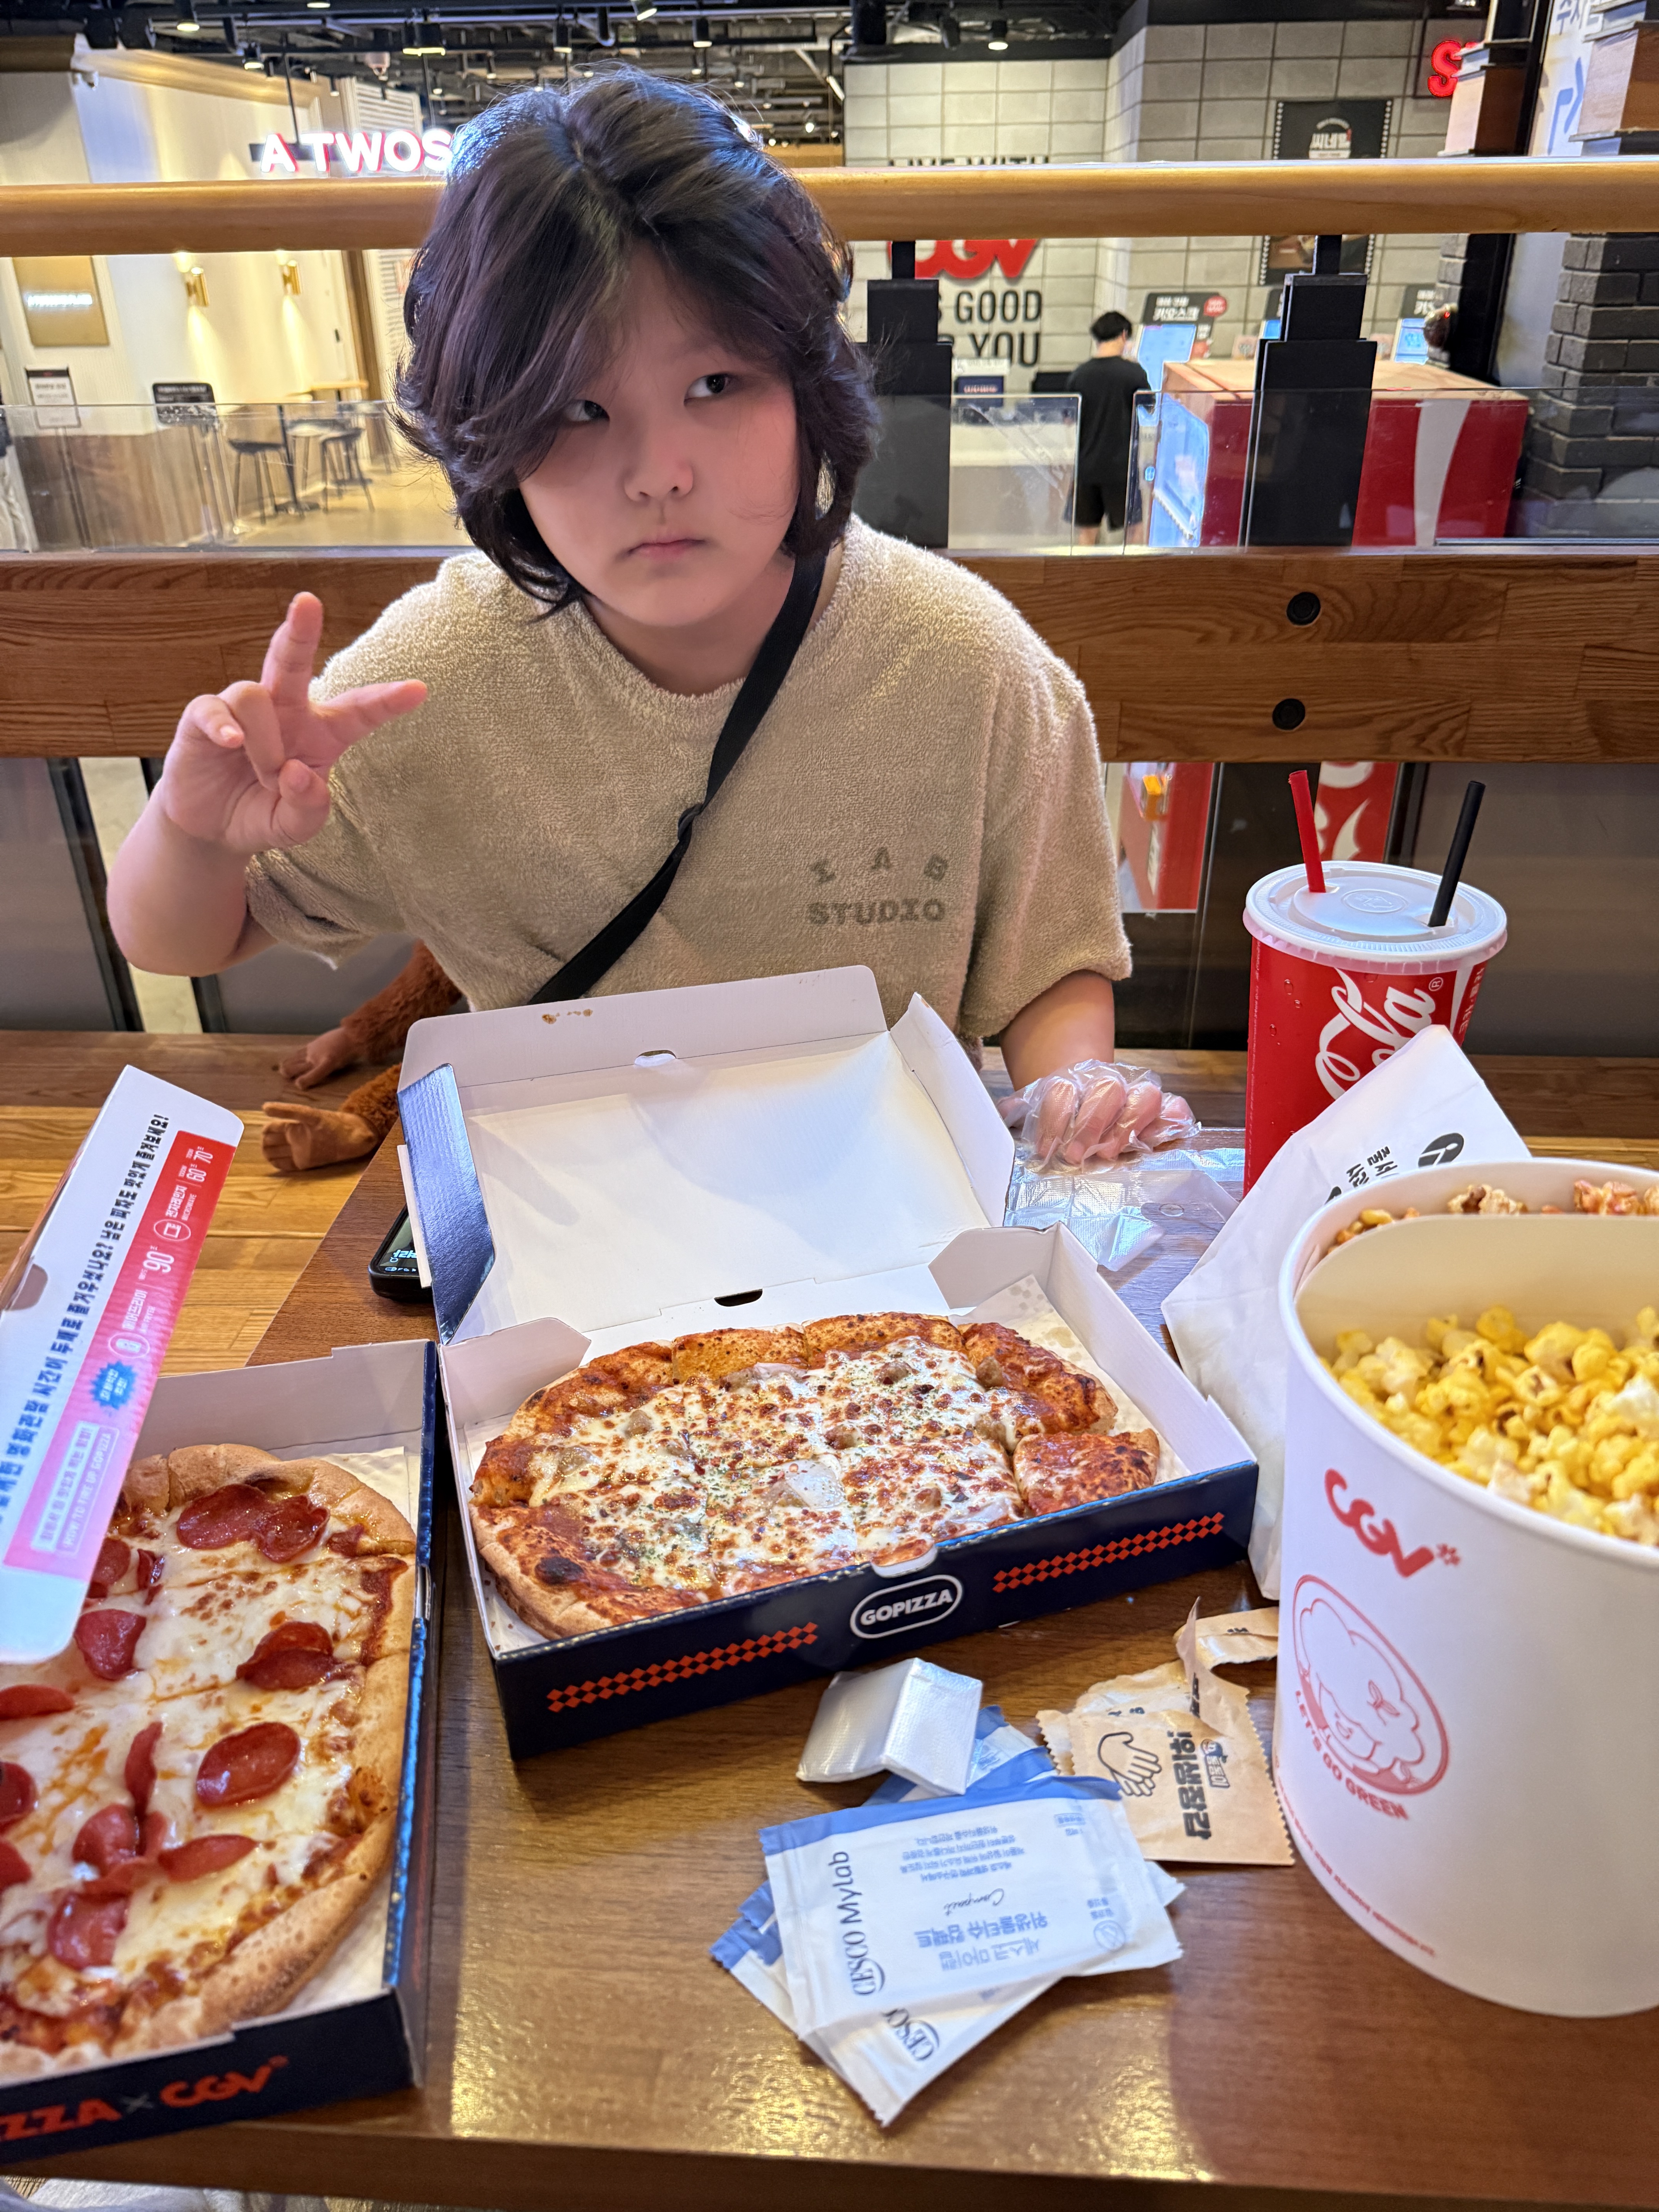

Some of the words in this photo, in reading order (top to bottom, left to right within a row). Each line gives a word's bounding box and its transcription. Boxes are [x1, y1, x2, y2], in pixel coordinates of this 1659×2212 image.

[261, 132, 298, 173] A
[955, 290, 1042, 323] GOOD
[968, 332, 1040, 367] YOU
[808, 898, 945, 925] STUDIO
[135, 1113, 170, 1161] 즐겨보세요!
[122, 1160, 151, 1189] 맛있게
[109, 1188, 139, 1220] 피자도
[165, 1184, 188, 1218] 전자레인지
[180, 1193, 198, 1221] MICROWAVE
[99, 1219, 125, 1242] 남은
[66, 1241, 115, 1316] 즐거우셨나요?
[49, 1316, 84, 1355] 두배로
[31, 1356, 68, 1397] 시간이
[61, 1521, 81, 1546] HOW
[71, 1506, 87, 1520] TO
[89, 1432, 113, 1470] GOPIZZA
[1325, 1469, 1434, 1578] CGV
[860, 1589, 953, 1625] GOPIZZA
[1322, 1753, 1342, 1781] GO
[1345, 1776, 1409, 1820] GREEN
[944, 1888, 1005, 1917] Compact
[914, 1924, 965, 1948] 컴팩트
[969, 1911, 1048, 1937] 위생물티슈
[843, 1931, 882, 1996] CESCO
[939, 1946, 988, 1972] 마이랩
[991, 1937, 1040, 1961] 세스코
[159, 2057, 290, 2108] CGV
